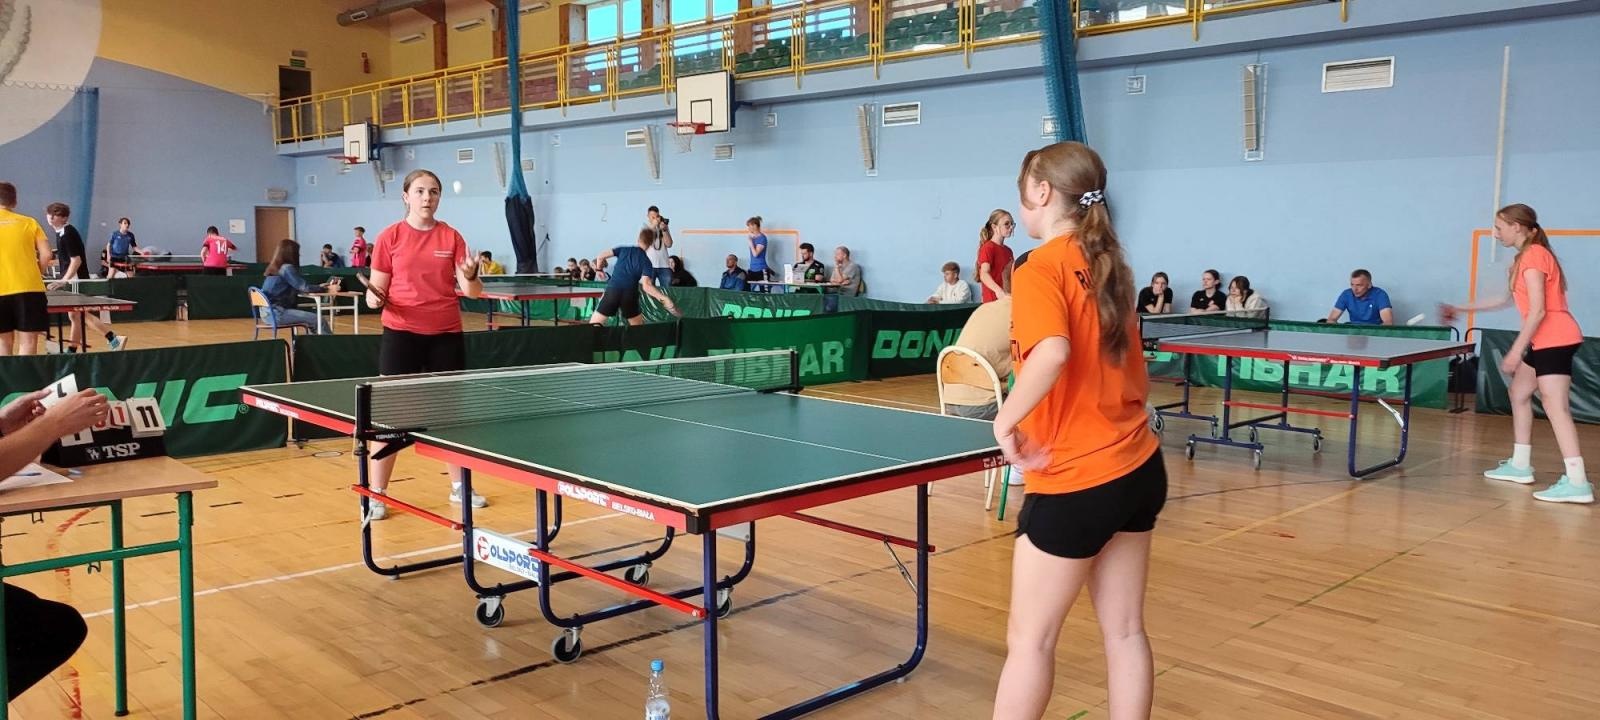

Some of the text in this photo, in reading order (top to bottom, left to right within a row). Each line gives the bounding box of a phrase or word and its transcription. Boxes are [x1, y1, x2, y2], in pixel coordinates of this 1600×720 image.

[215, 239, 227, 255] 14
[872, 329, 962, 358] DONI
[136, 405, 159, 428] 11
[102, 442, 140, 458] TSP
